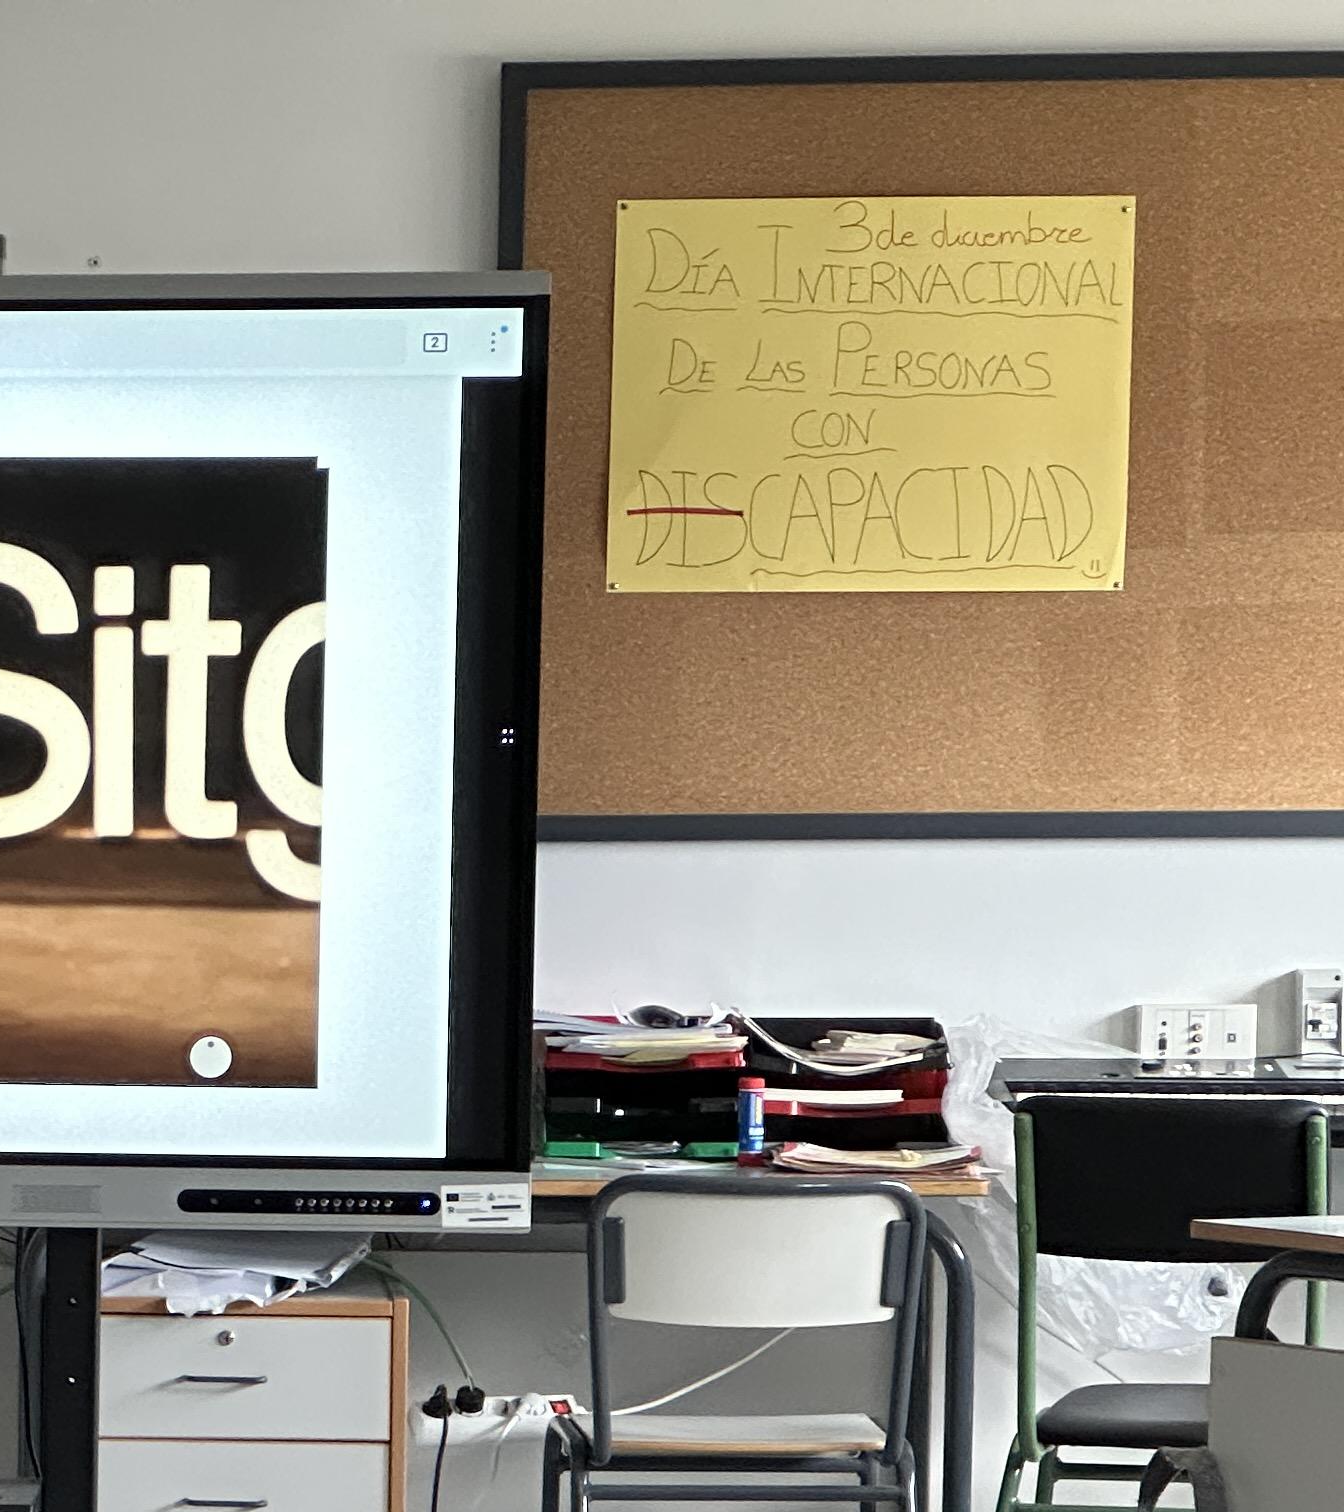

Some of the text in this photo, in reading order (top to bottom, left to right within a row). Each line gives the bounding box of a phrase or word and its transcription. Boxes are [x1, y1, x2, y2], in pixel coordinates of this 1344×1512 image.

[757, 224, 1124, 308] INTERNACIONAL
[832, 320, 1054, 391] PERSONAS
[791, 408, 876, 450] CON
[634, 463, 1094, 568] DISCAPACIDAD
